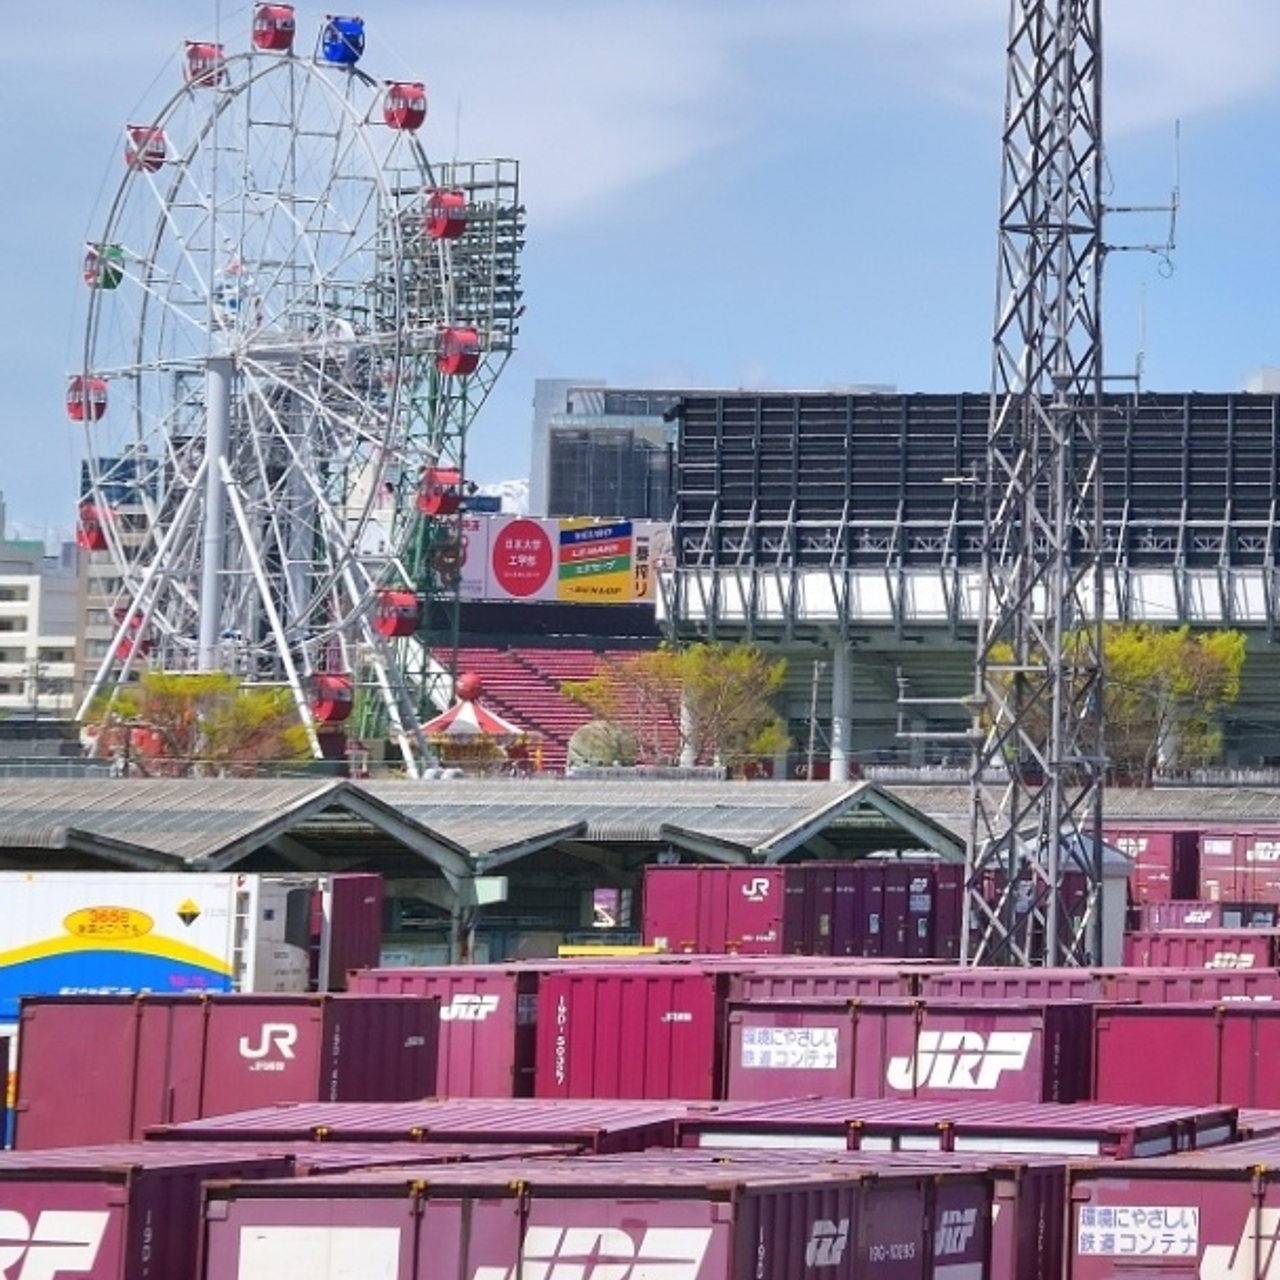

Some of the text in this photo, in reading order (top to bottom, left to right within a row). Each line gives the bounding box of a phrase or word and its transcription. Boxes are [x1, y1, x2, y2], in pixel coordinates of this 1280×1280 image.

[742, 878, 769, 896] JR
[439, 993, 500, 1021] JRF
[240, 1023, 298, 1059] JR
[886, 1031, 1033, 1091] JRF
[934, 1208, 977, 1256] JRF
[1080, 1207, 1199, 1229] 環境にやさしい
[1080, 1232, 1197, 1255] 鉄道コンテナ
